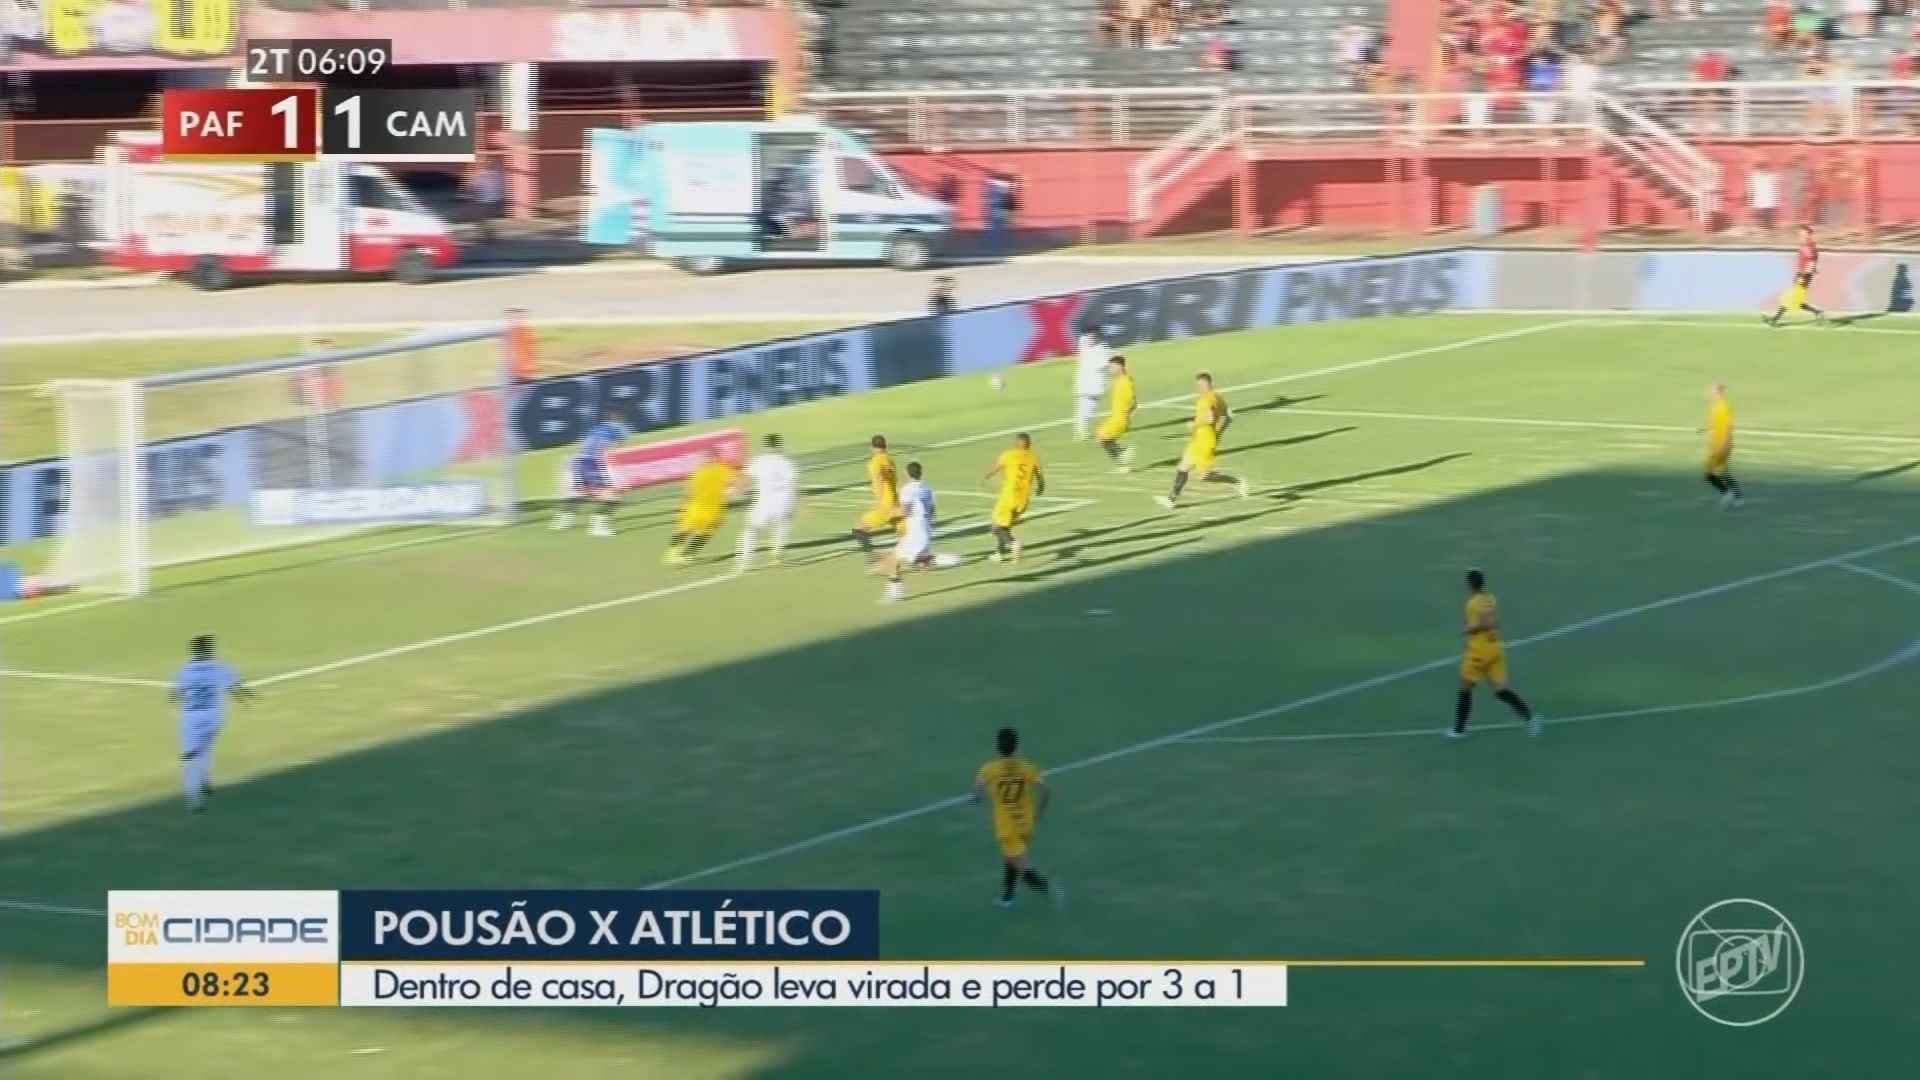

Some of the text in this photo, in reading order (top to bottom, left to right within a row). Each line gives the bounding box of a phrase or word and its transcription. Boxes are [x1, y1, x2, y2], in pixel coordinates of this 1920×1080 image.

[1276, 256, 1460, 325] PNEUS
[705, 336, 849, 420] PNEUS
[996, 778, 1025, 805] 27
